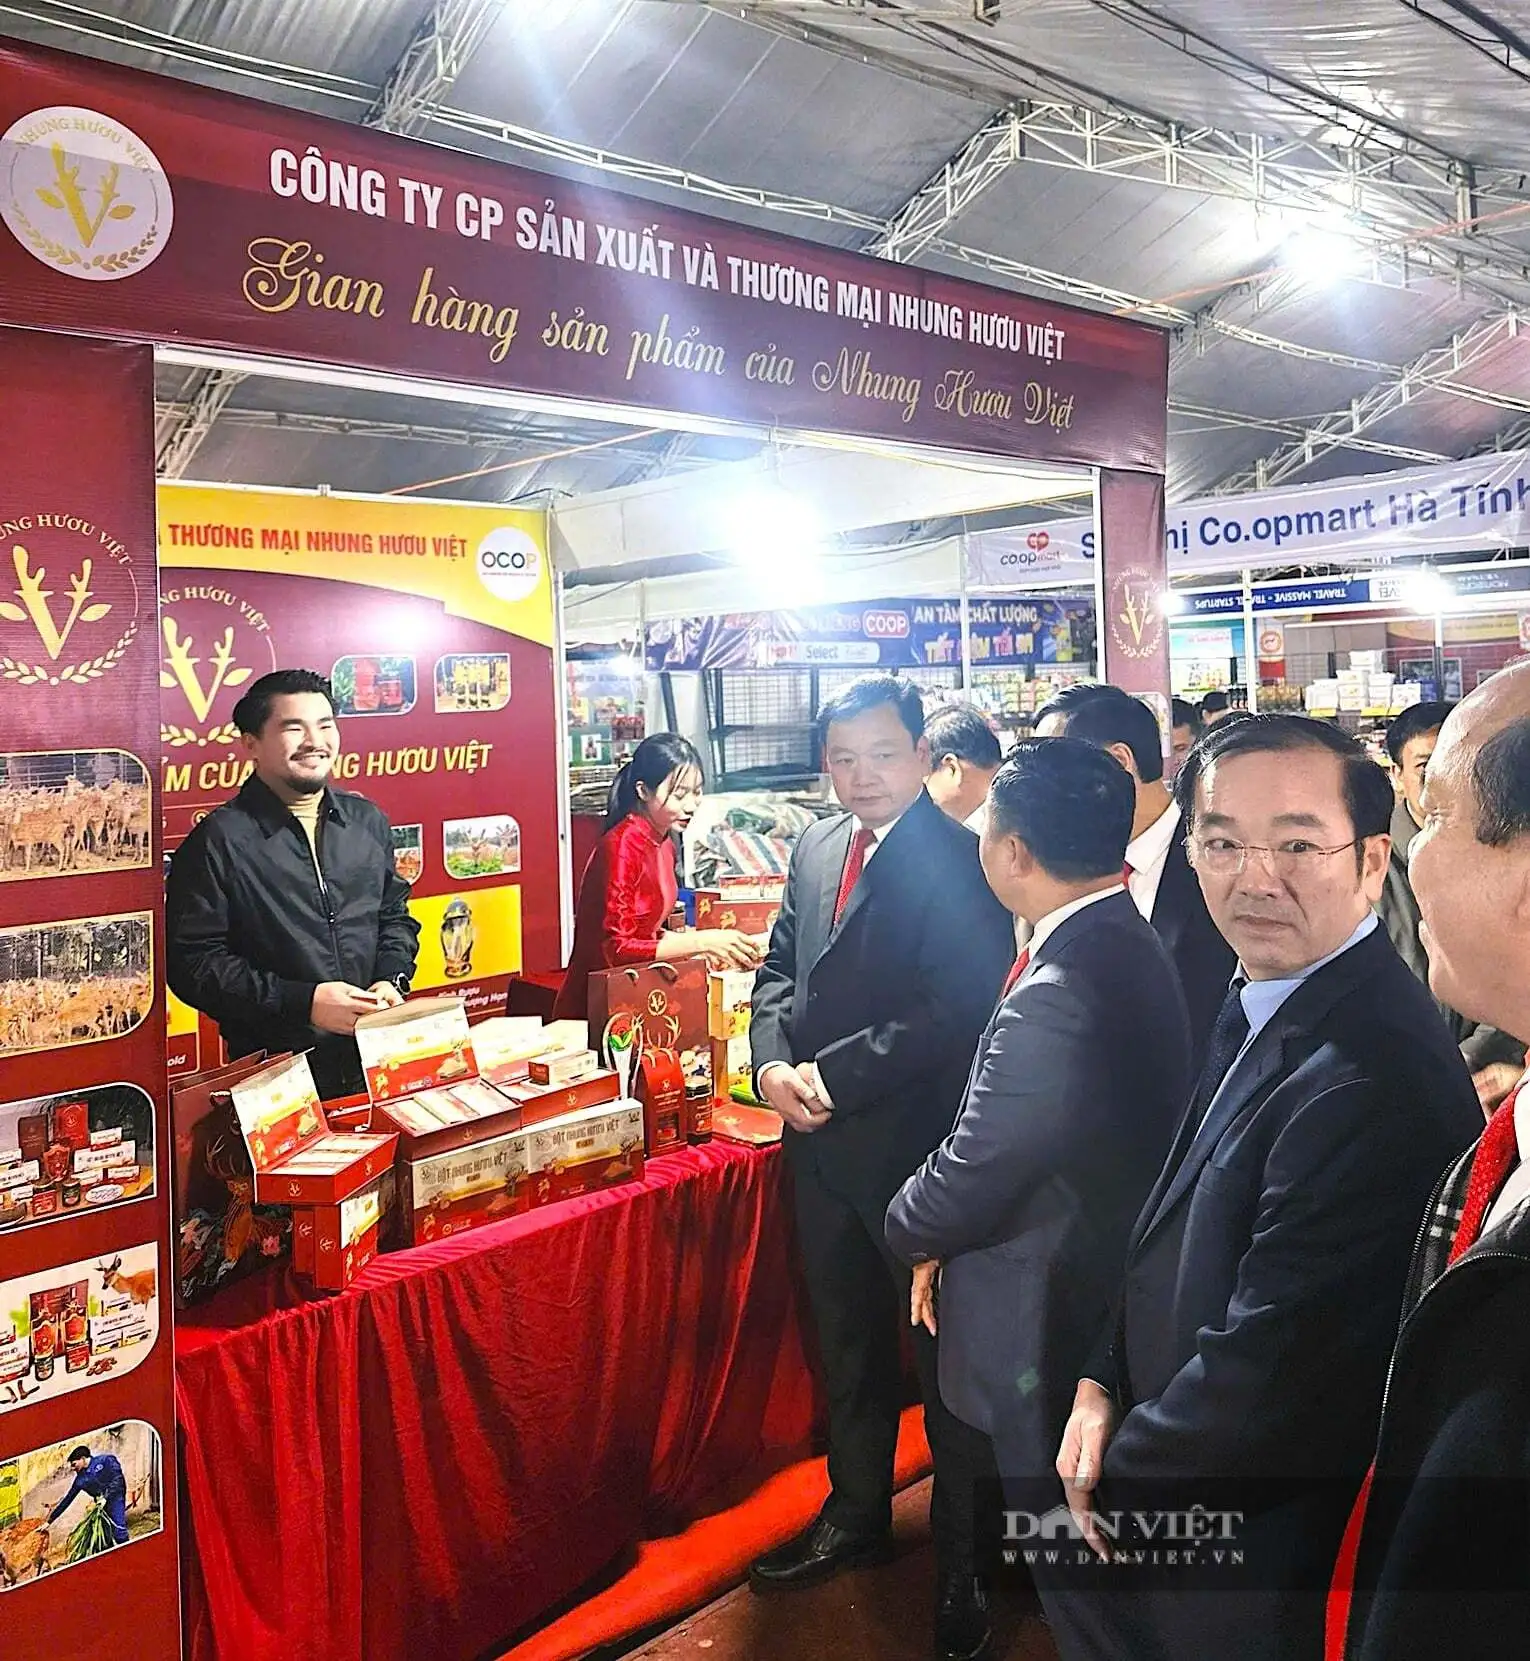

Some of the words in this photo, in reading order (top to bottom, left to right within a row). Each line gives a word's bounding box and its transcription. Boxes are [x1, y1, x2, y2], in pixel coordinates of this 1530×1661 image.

[270, 146, 387, 217] CÔNG
[398, 178, 444, 229] TY
[455, 191, 504, 241] CP
[515, 198, 586, 260] SẢN
[595, 223, 675, 280] XUẤT
[682, 241, 720, 290] VÀ
[728, 256, 830, 313] THƯƠNG
[836, 280, 883, 330] MẠI
[888, 291, 963, 342] NHUNG
[968, 310, 1022, 352] HƯƠU
[1025, 323, 1066, 367] VIỆT
[242, 236, 386, 319] Gian
[410, 266, 519, 364] hàng
[541, 306, 609, 358] sản
[625, 313, 726, 381] phẩm
[743, 341, 795, 388] của
[811, 346, 922, 423] Nhung
[933, 368, 1014, 421] Hươu
[1023, 380, 1076, 437] Việt
[1199, 498, 1377, 547] Co.opmart
[1389, 489, 1438, 527] Hà
[1450, 478, 1530, 517] Tĩnh
[37, 513, 96, 536] HƯƠU
[99, 531, 133, 565] VIỆT
[168, 523, 254, 550] THƯƠNG
[260, 528, 300, 556] MẠI
[306, 531, 373, 554] NHUNG
[379, 533, 427, 557] HƯƠU
[432, 533, 468, 563] VIỆT
[481, 551, 537, 569] OCOP
[184, 585, 238, 606] HƯƠU
[240, 600, 271, 632] VIỆT
[914, 604, 934, 623] AN
[999, 604, 1037, 627] LƯỢNG
[1236, 594, 1267, 607] TRAEL
[1275, 590, 1312, 604] MASSIVE
[1314, 588, 1347, 601] TRAVEL
[199, 752, 255, 792] CỦA
[366, 746, 438, 777] HƯƠU
[443, 739, 493, 775] VIỆT
